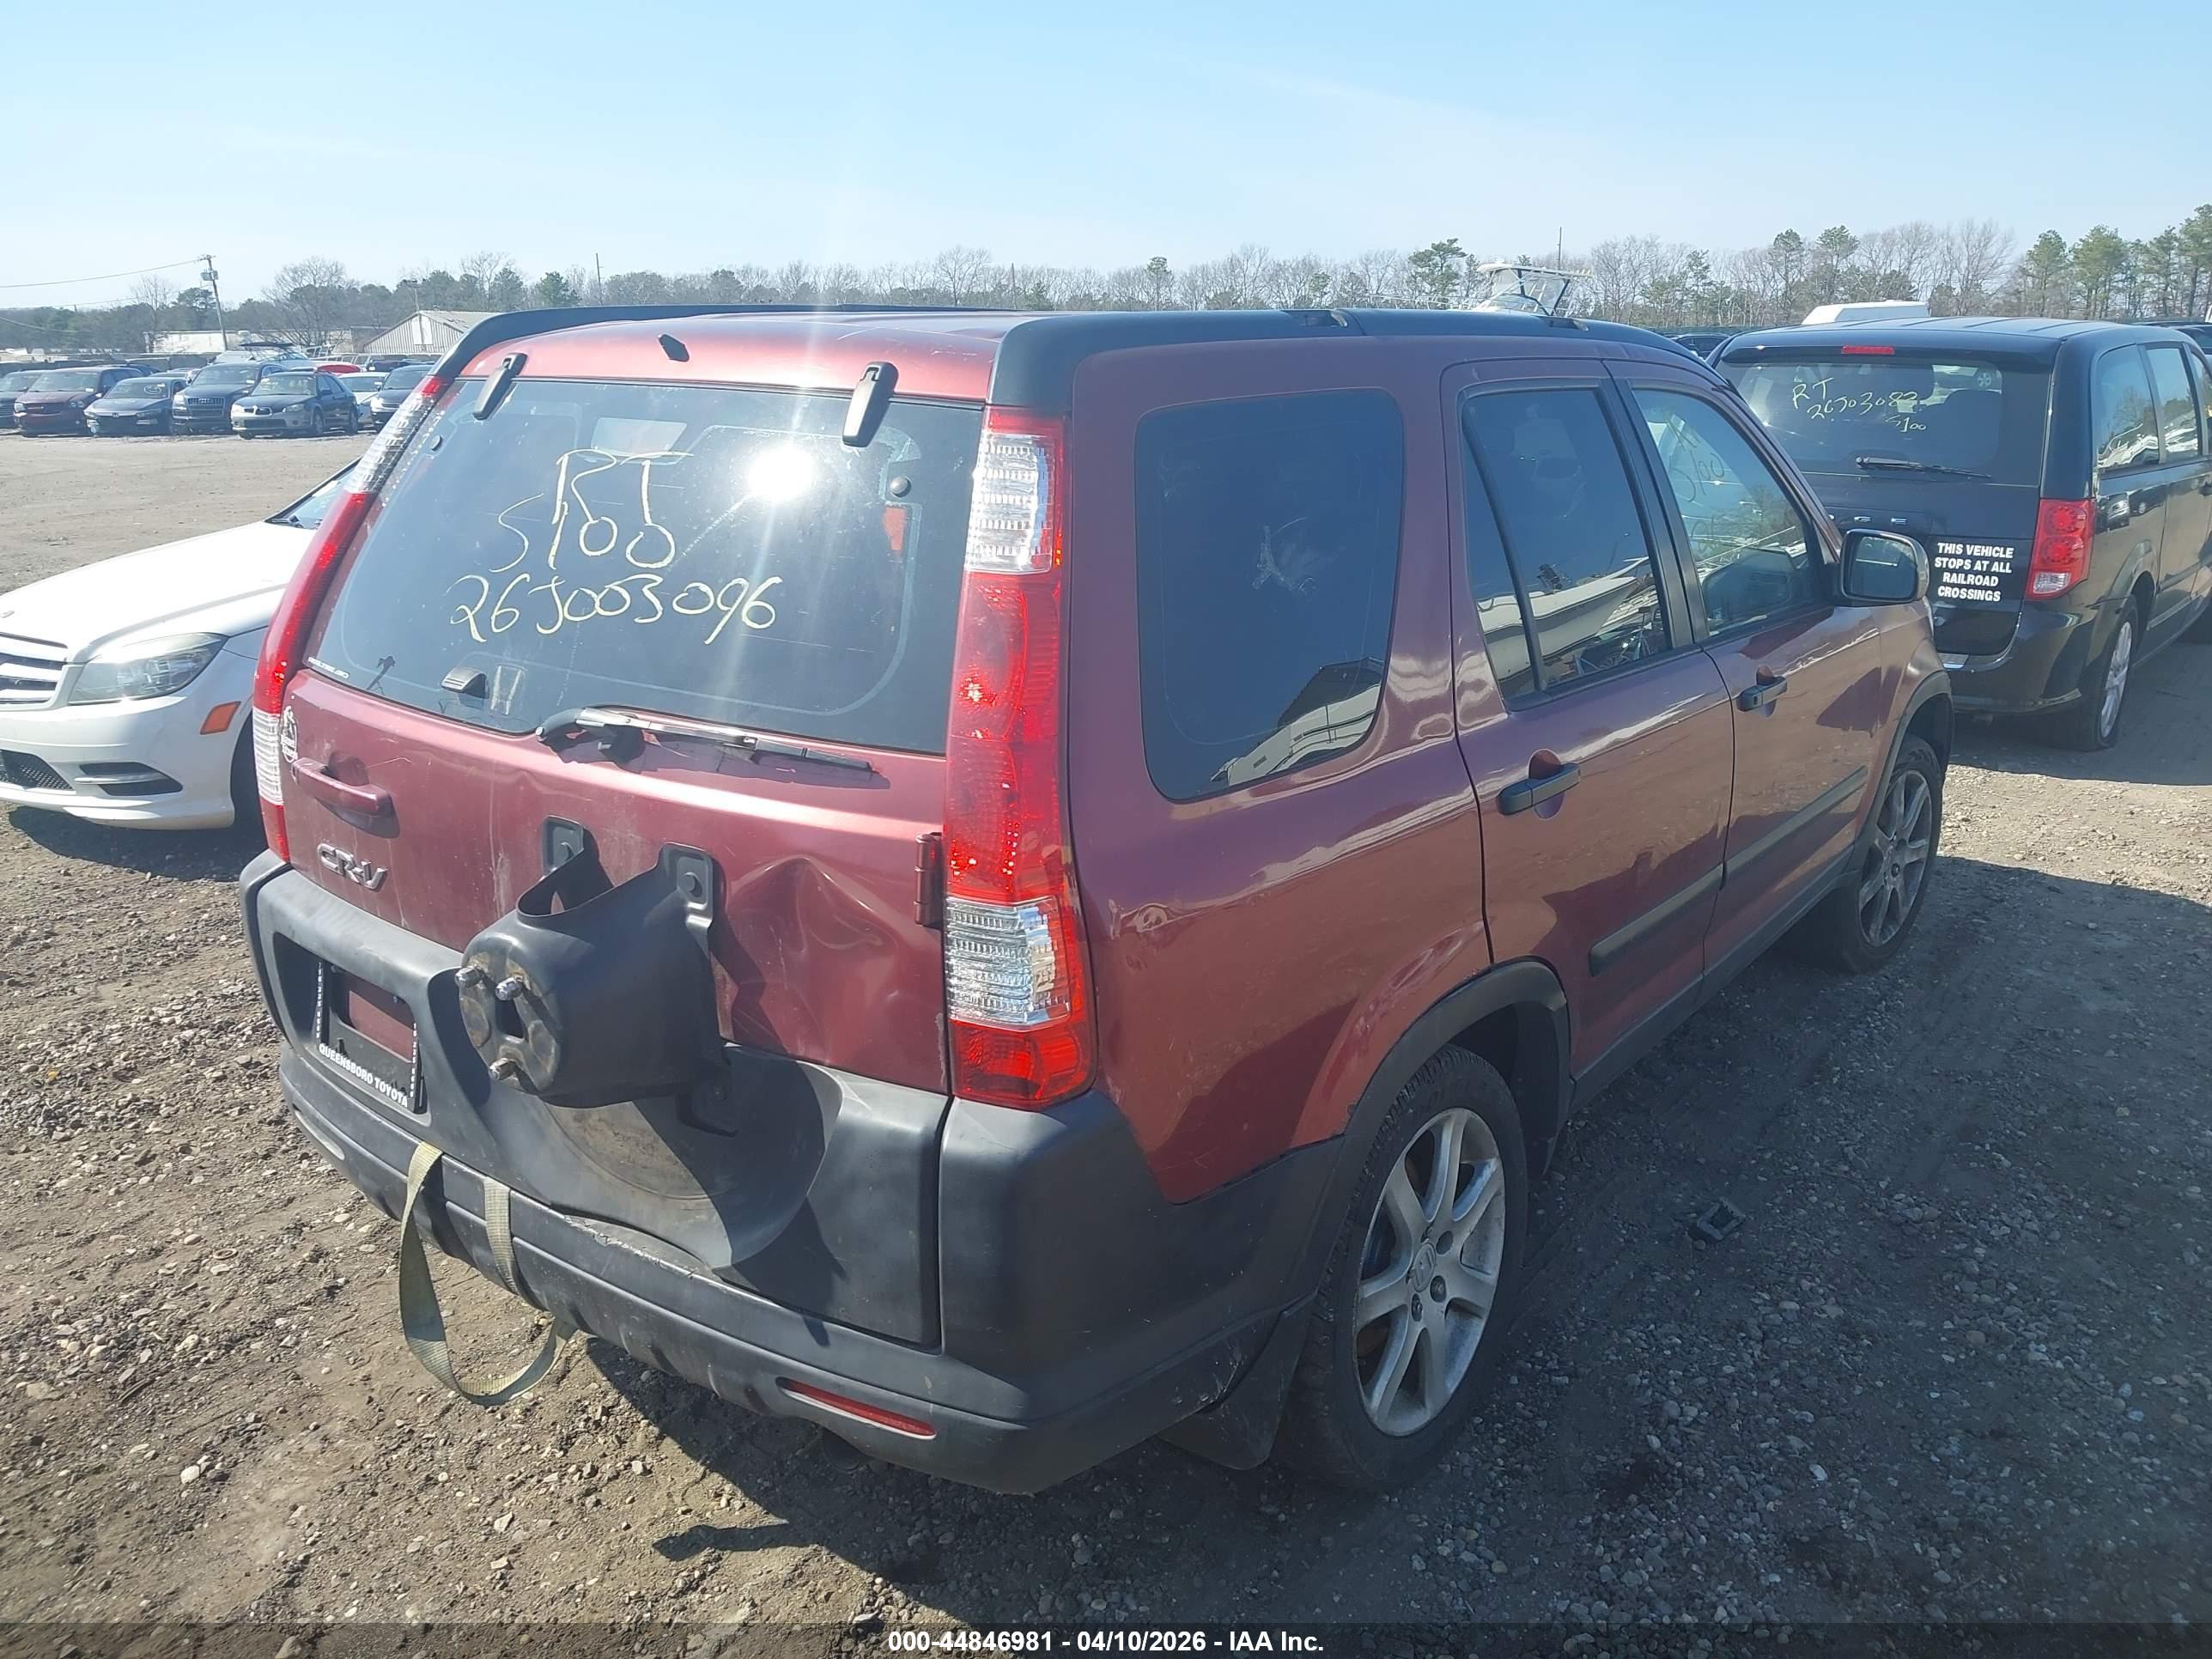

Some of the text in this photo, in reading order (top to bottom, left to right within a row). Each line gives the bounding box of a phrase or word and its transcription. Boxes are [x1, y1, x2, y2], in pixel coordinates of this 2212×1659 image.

[1793, 378, 1834, 410] RT
[553, 449, 694, 525] RT
[1937, 542, 2014, 559] THIS VEHICLE
[1934, 556, 2013, 574] STOPS AT ALL
[1942, 572, 1999, 586] RAILROAD
[1937, 585, 2002, 602] CROSSINGS
[319, 1042, 374, 1085] QUEENSBORO
[374, 1077, 408, 1108] TOYOTA
